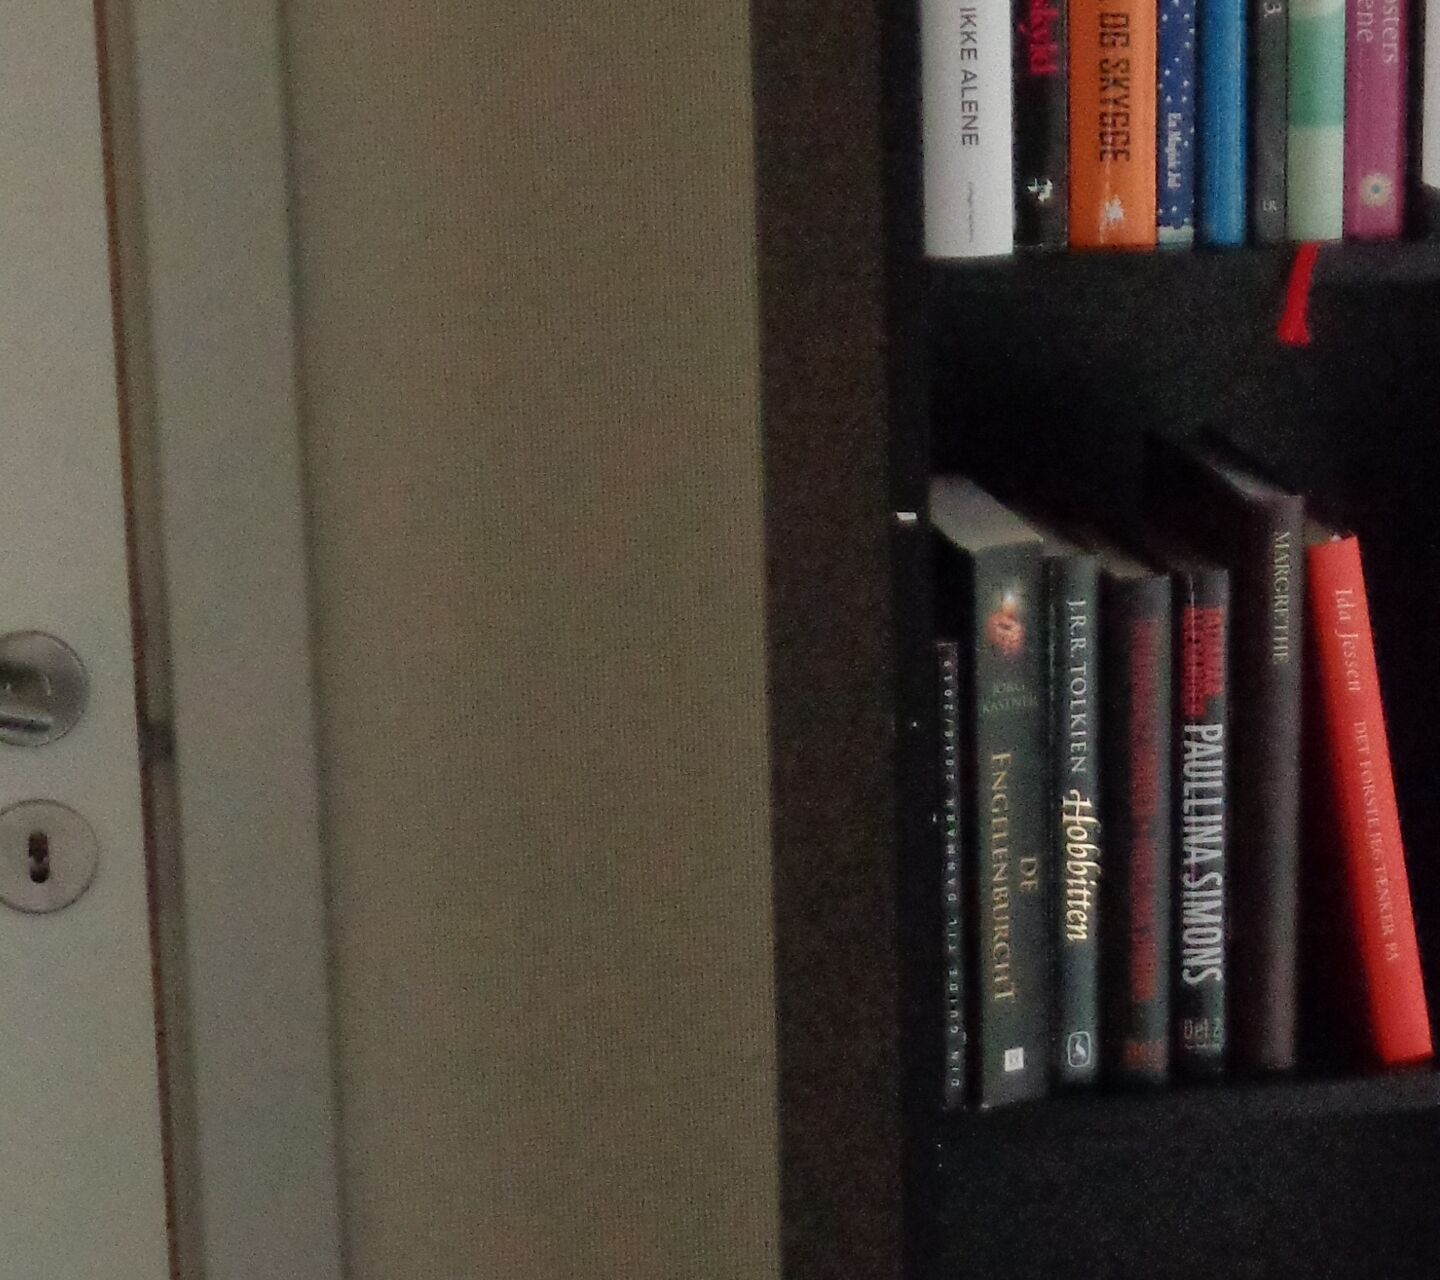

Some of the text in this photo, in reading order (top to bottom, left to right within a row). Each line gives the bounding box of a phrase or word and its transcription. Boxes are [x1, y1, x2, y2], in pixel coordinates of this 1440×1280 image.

[958, 6, 979, 61] IKKE
[1098, 12, 1131, 48] OG
[959, 68, 981, 147] ALENE
[1098, 53, 1131, 163] SKYGGE
[1272, 529, 1291, 665] MARGRETHE
[1334, 588, 1362, 694] Ida Jessen
[1061, 598, 1101, 943] J.R.R. TOLKIEN Hobbitten
[1353, 720, 1370, 756] DET
[1182, 722, 1224, 867] PAULLINA
[945, 798, 958, 903] DANMARK
[1182, 870, 1223, 985] SIMONS
